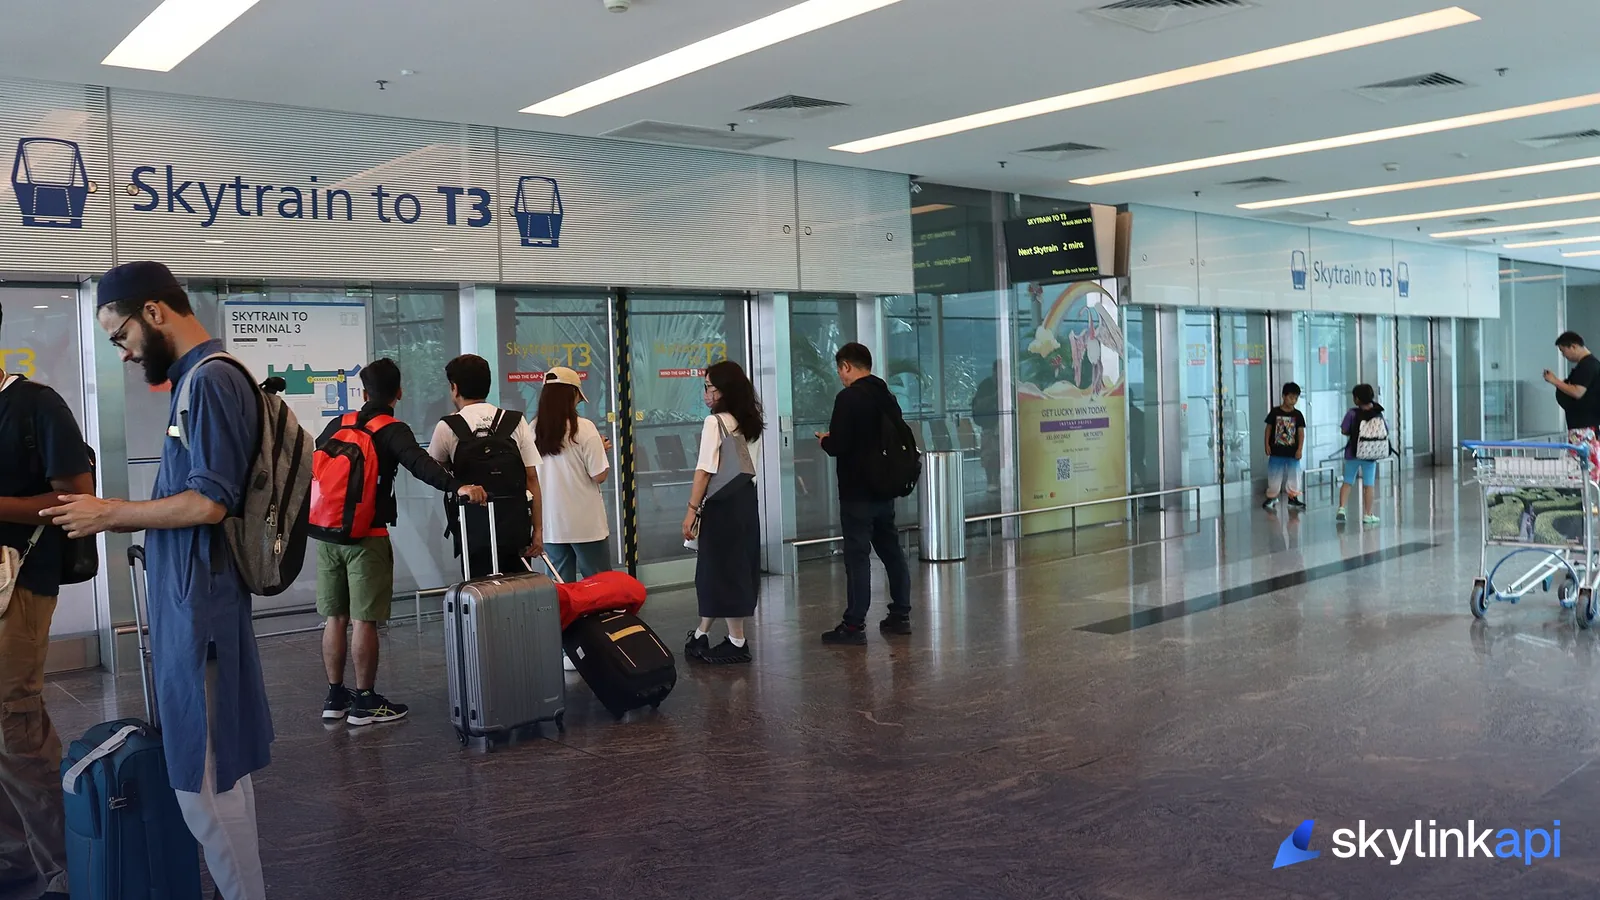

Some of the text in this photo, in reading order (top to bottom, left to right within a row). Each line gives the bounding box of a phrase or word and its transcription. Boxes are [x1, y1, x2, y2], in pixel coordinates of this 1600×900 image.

[131, 164, 492, 228] Skytrain to T3
[1018, 240, 1084, 257] Next Skytrain 2 mins
[1313, 260, 1392, 289] Skytrain to T3
[231, 311, 308, 322] SKYTRAIN TO
[233, 323, 301, 334] TERMINAL 3
[505, 342, 592, 368] Skytrain T3
[703, 343, 728, 365] T3
[546, 356, 560, 368] to
[349, 387, 361, 397] T1
[1041, 408, 1055, 418] GET
[1075, 407, 1088, 416] WIN
